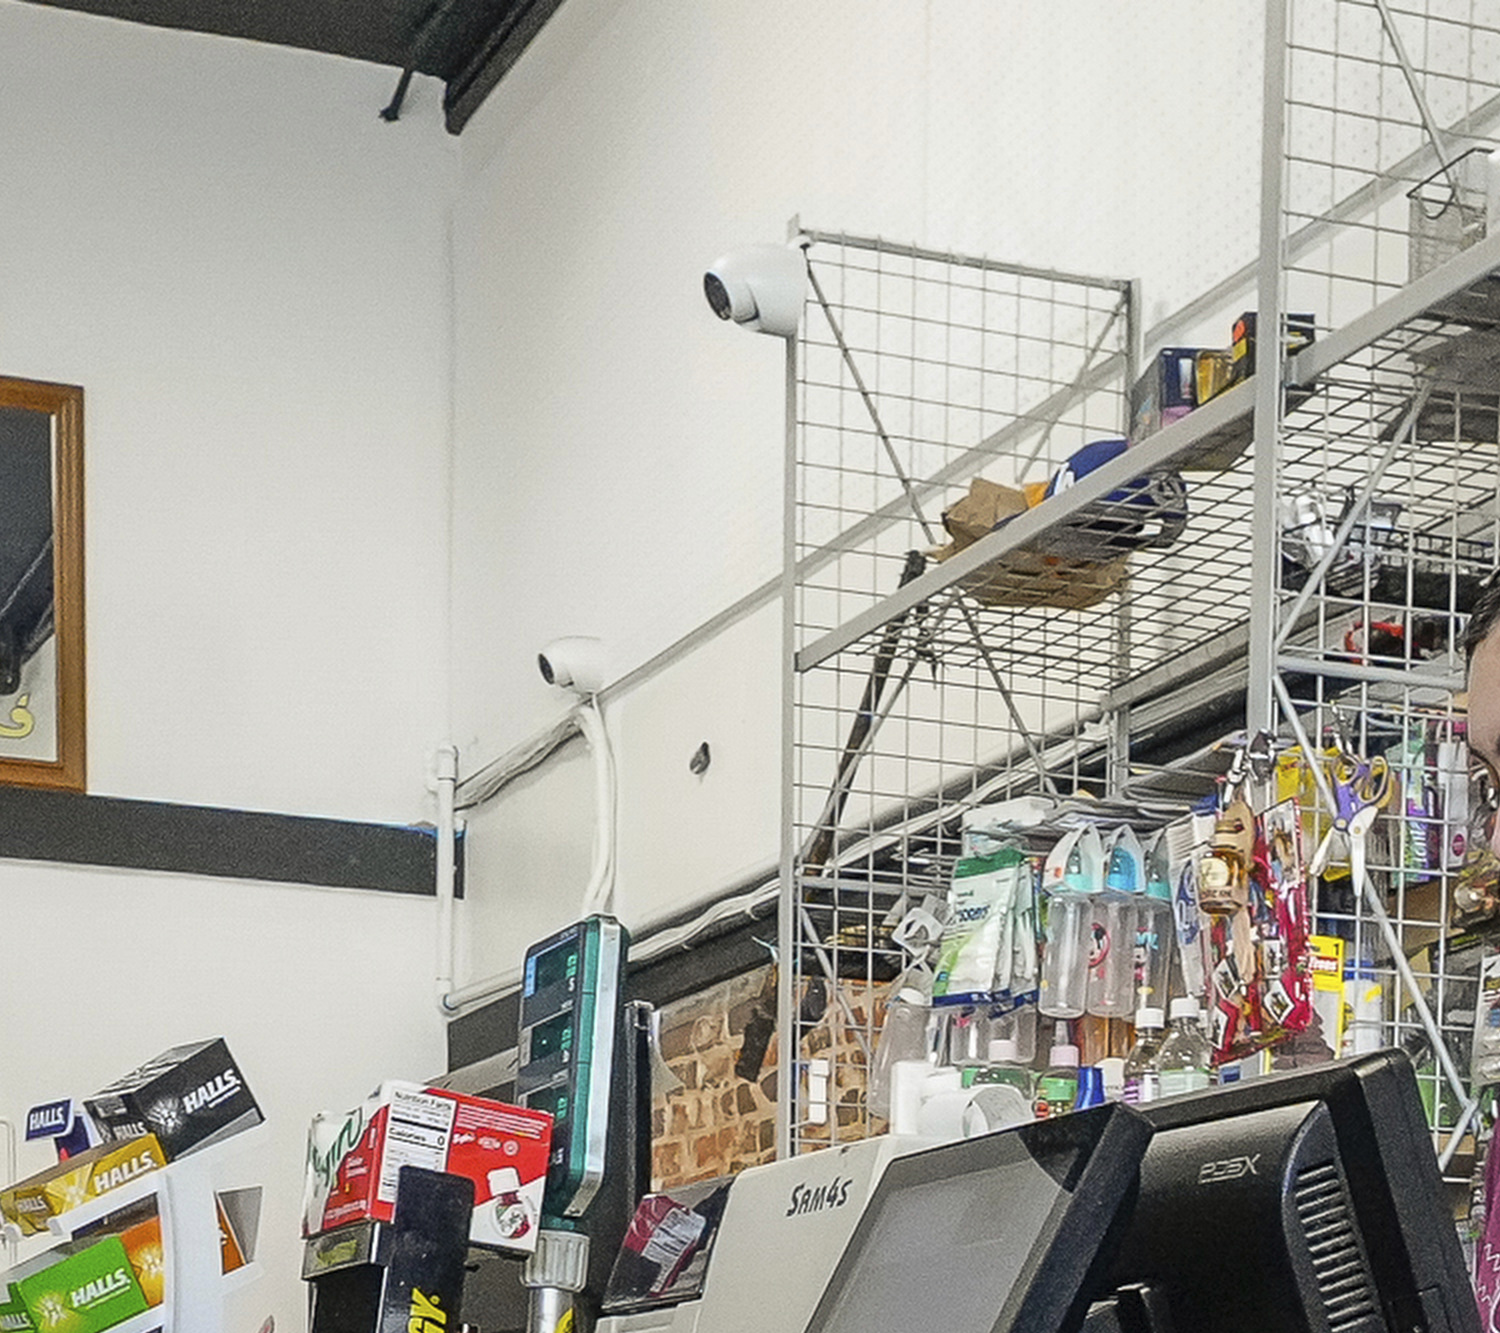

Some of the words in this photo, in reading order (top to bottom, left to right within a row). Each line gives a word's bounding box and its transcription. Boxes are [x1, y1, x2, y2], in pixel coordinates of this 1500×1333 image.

[181, 1068, 243, 1114] HALLS
[28, 1104, 65, 1132] HALLS
[93, 1152, 158, 1193] HALLS
[70, 1268, 132, 1307] HALLS
